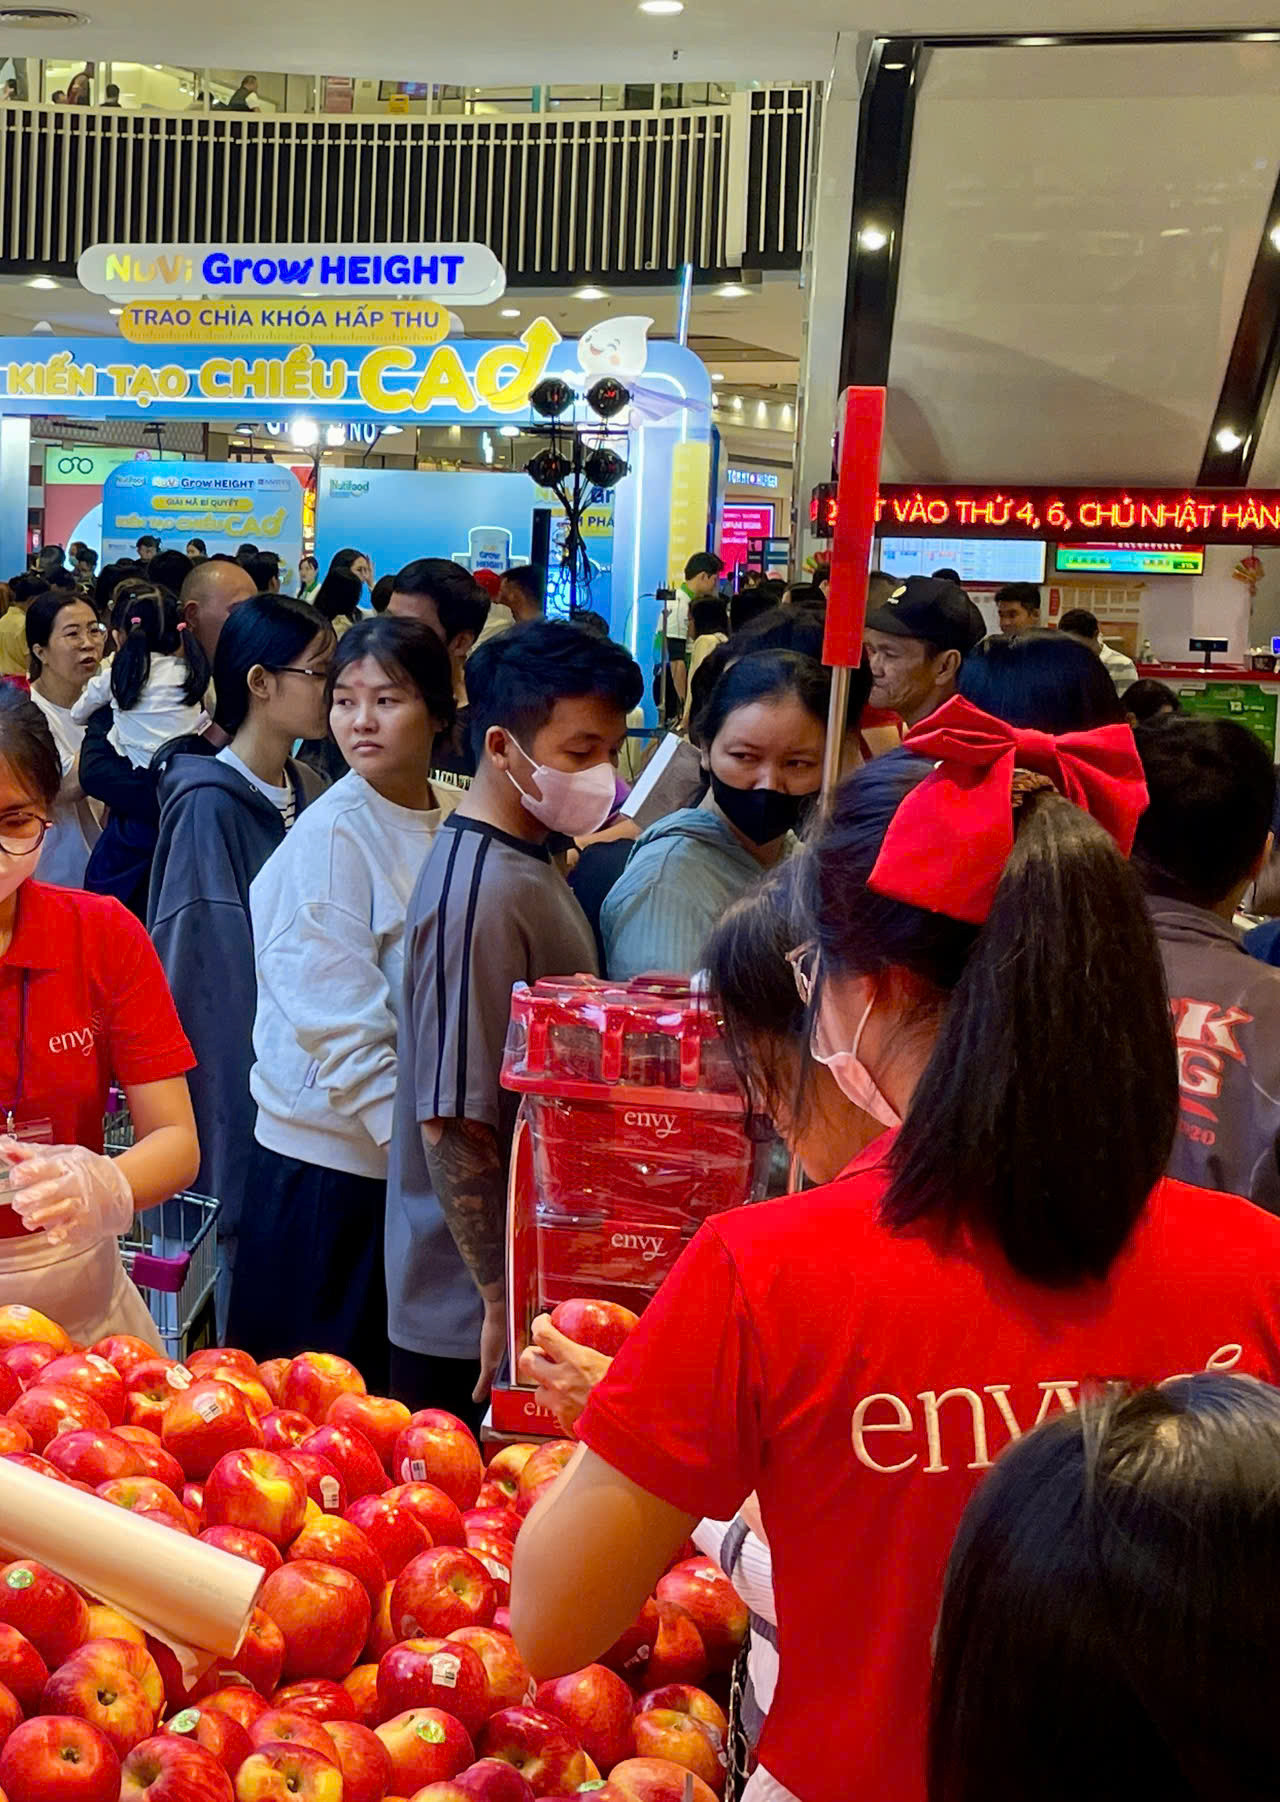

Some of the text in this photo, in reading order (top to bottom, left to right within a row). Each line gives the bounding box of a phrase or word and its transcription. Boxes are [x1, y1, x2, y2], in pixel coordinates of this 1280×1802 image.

[105, 253, 193, 283] NuVi
[130, 303, 439, 328] TRAO CHÌA KHÓA HẤP THU
[7, 351, 97, 397] KIẾN
[107, 364, 191, 408] TẠO
[358, 316, 562, 413] CAO
[893, 493, 950, 523] VÀO
[955, 495, 1015, 525] THỨ
[1016, 501, 1041, 530] 4,
[1047, 501, 1072, 531] 6,
[1141, 496, 1216, 532] NHẬT
[49, 1026, 97, 1057] envy
[1170, 997, 1255, 1066] K
[624, 1110, 681, 1139] envy
[610, 1232, 668, 1261] envy
